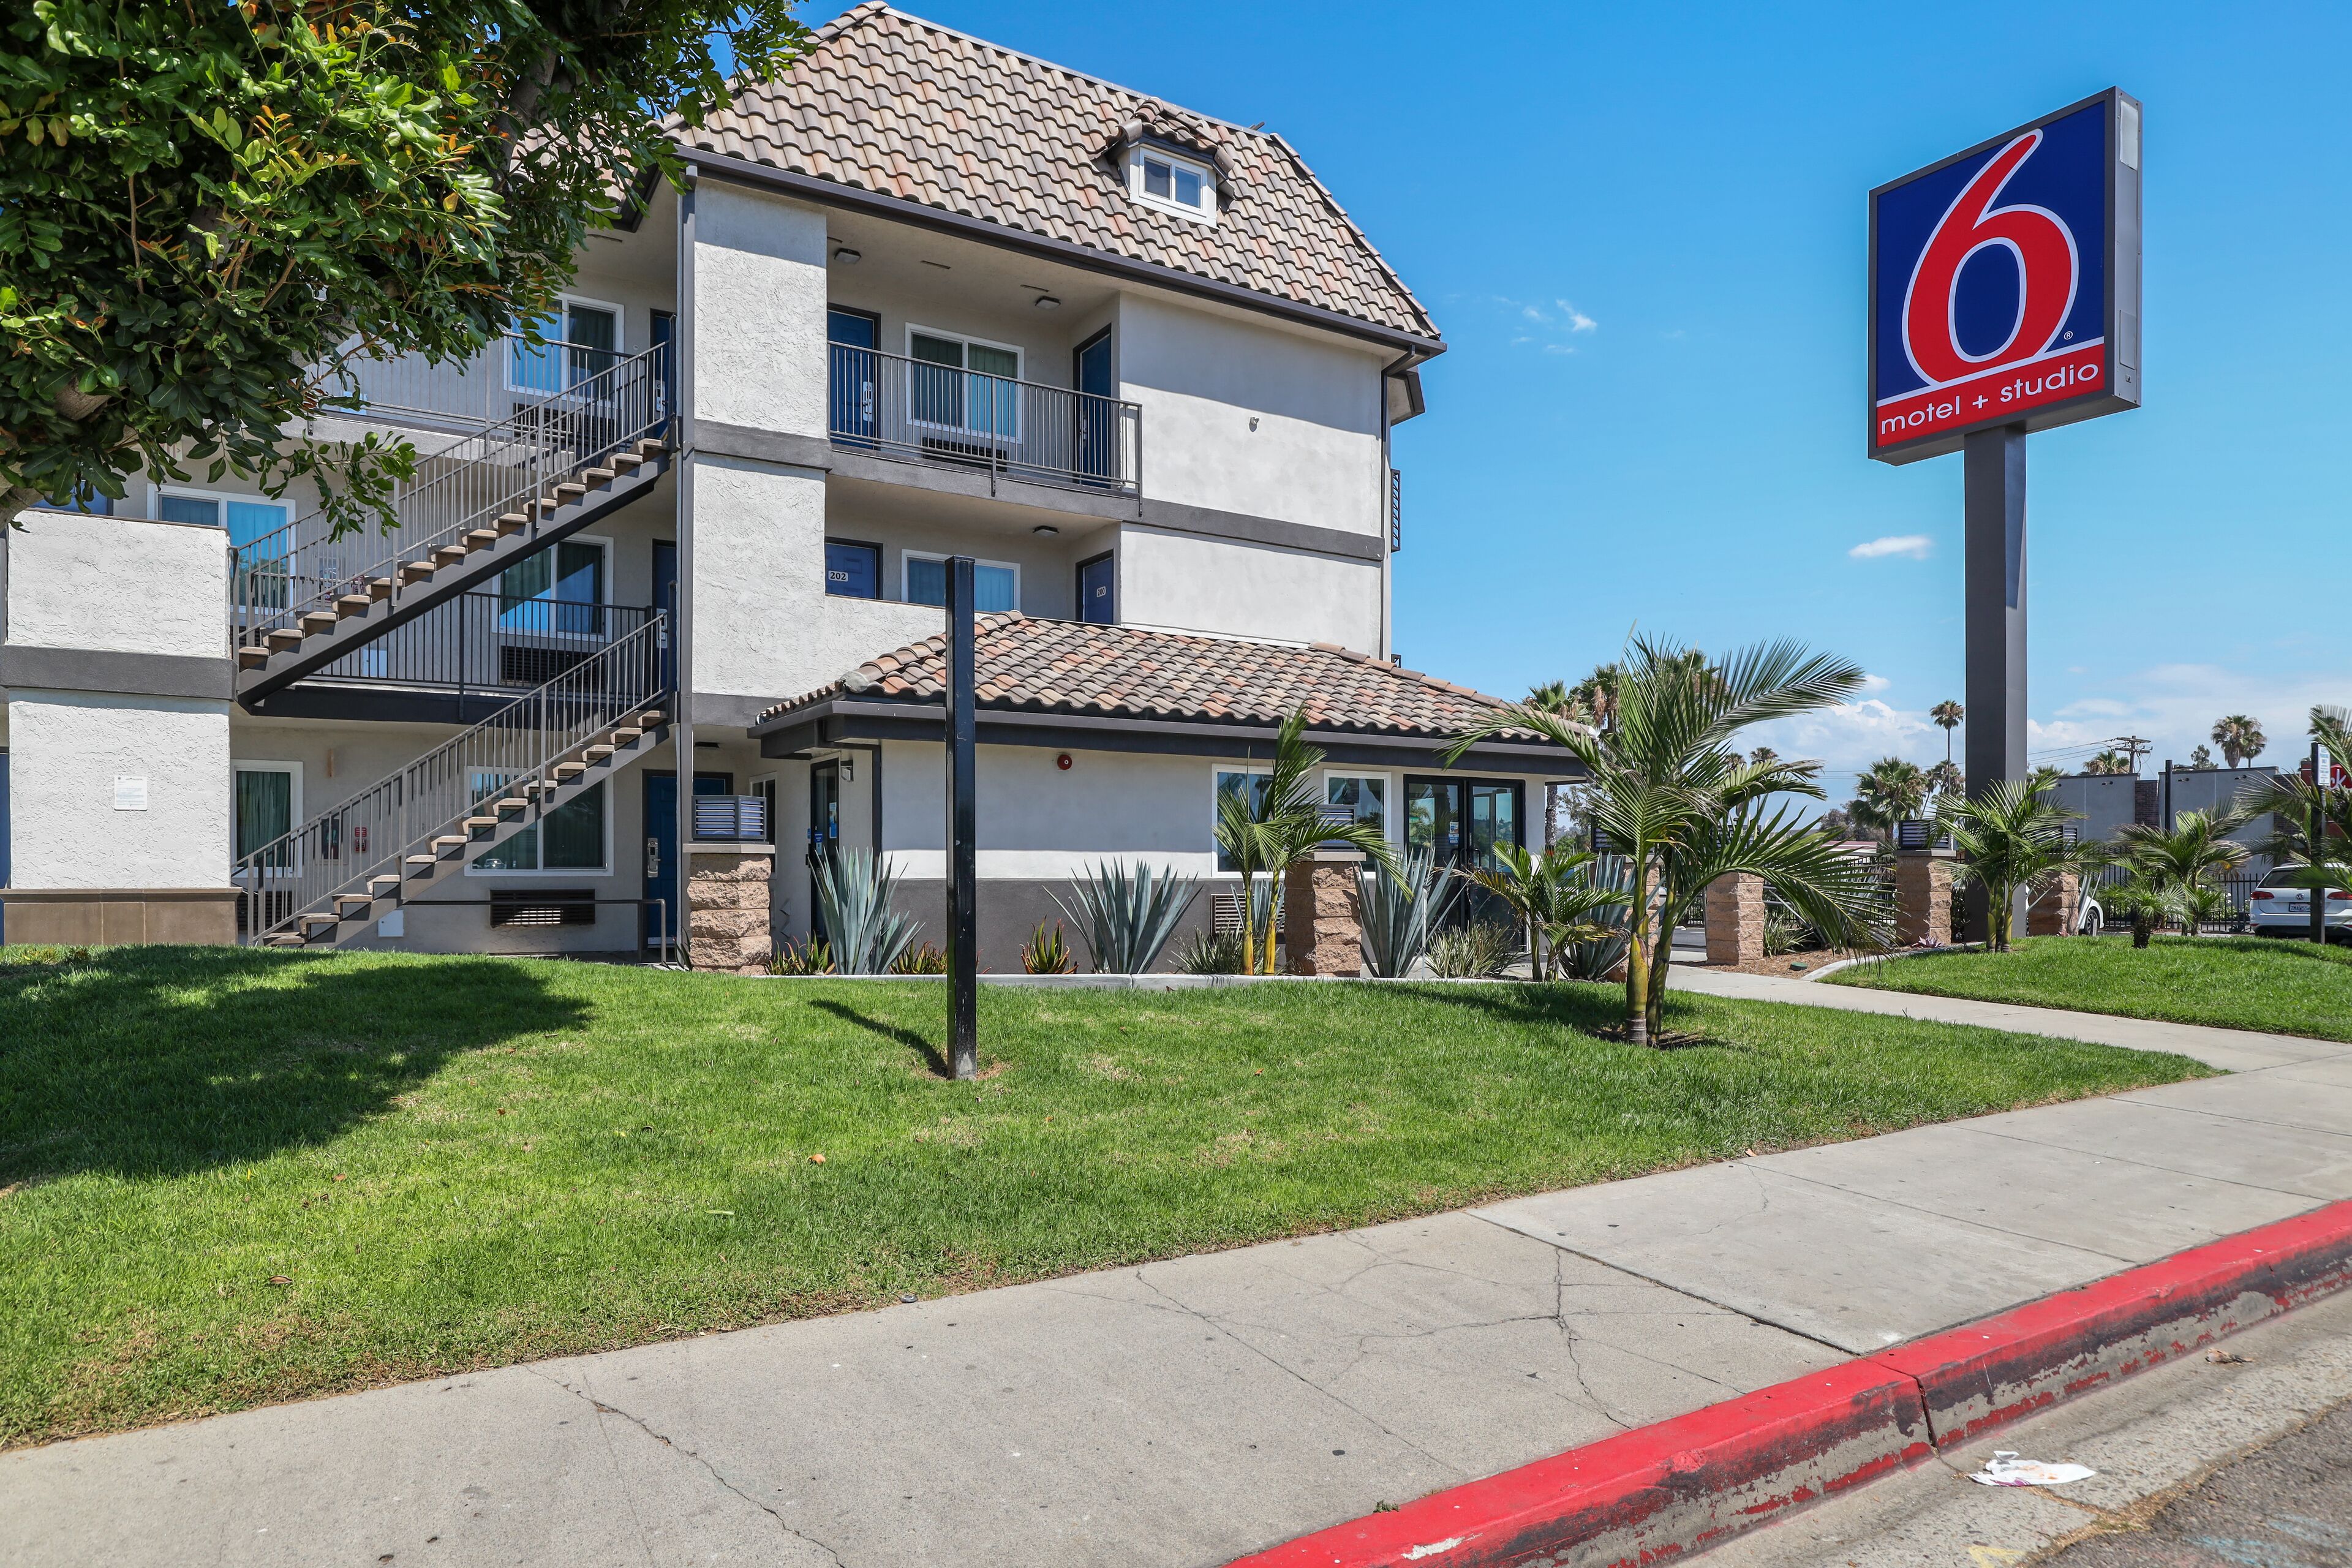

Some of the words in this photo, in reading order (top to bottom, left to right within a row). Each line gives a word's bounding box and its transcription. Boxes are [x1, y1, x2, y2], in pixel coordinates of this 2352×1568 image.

[1902, 128, 2079, 385] 6
[1882, 396, 1960, 434] motel
[1972, 395, 1989, 409] +
[2000, 364, 2098, 402] studio
[830, 571, 846, 580] 202
